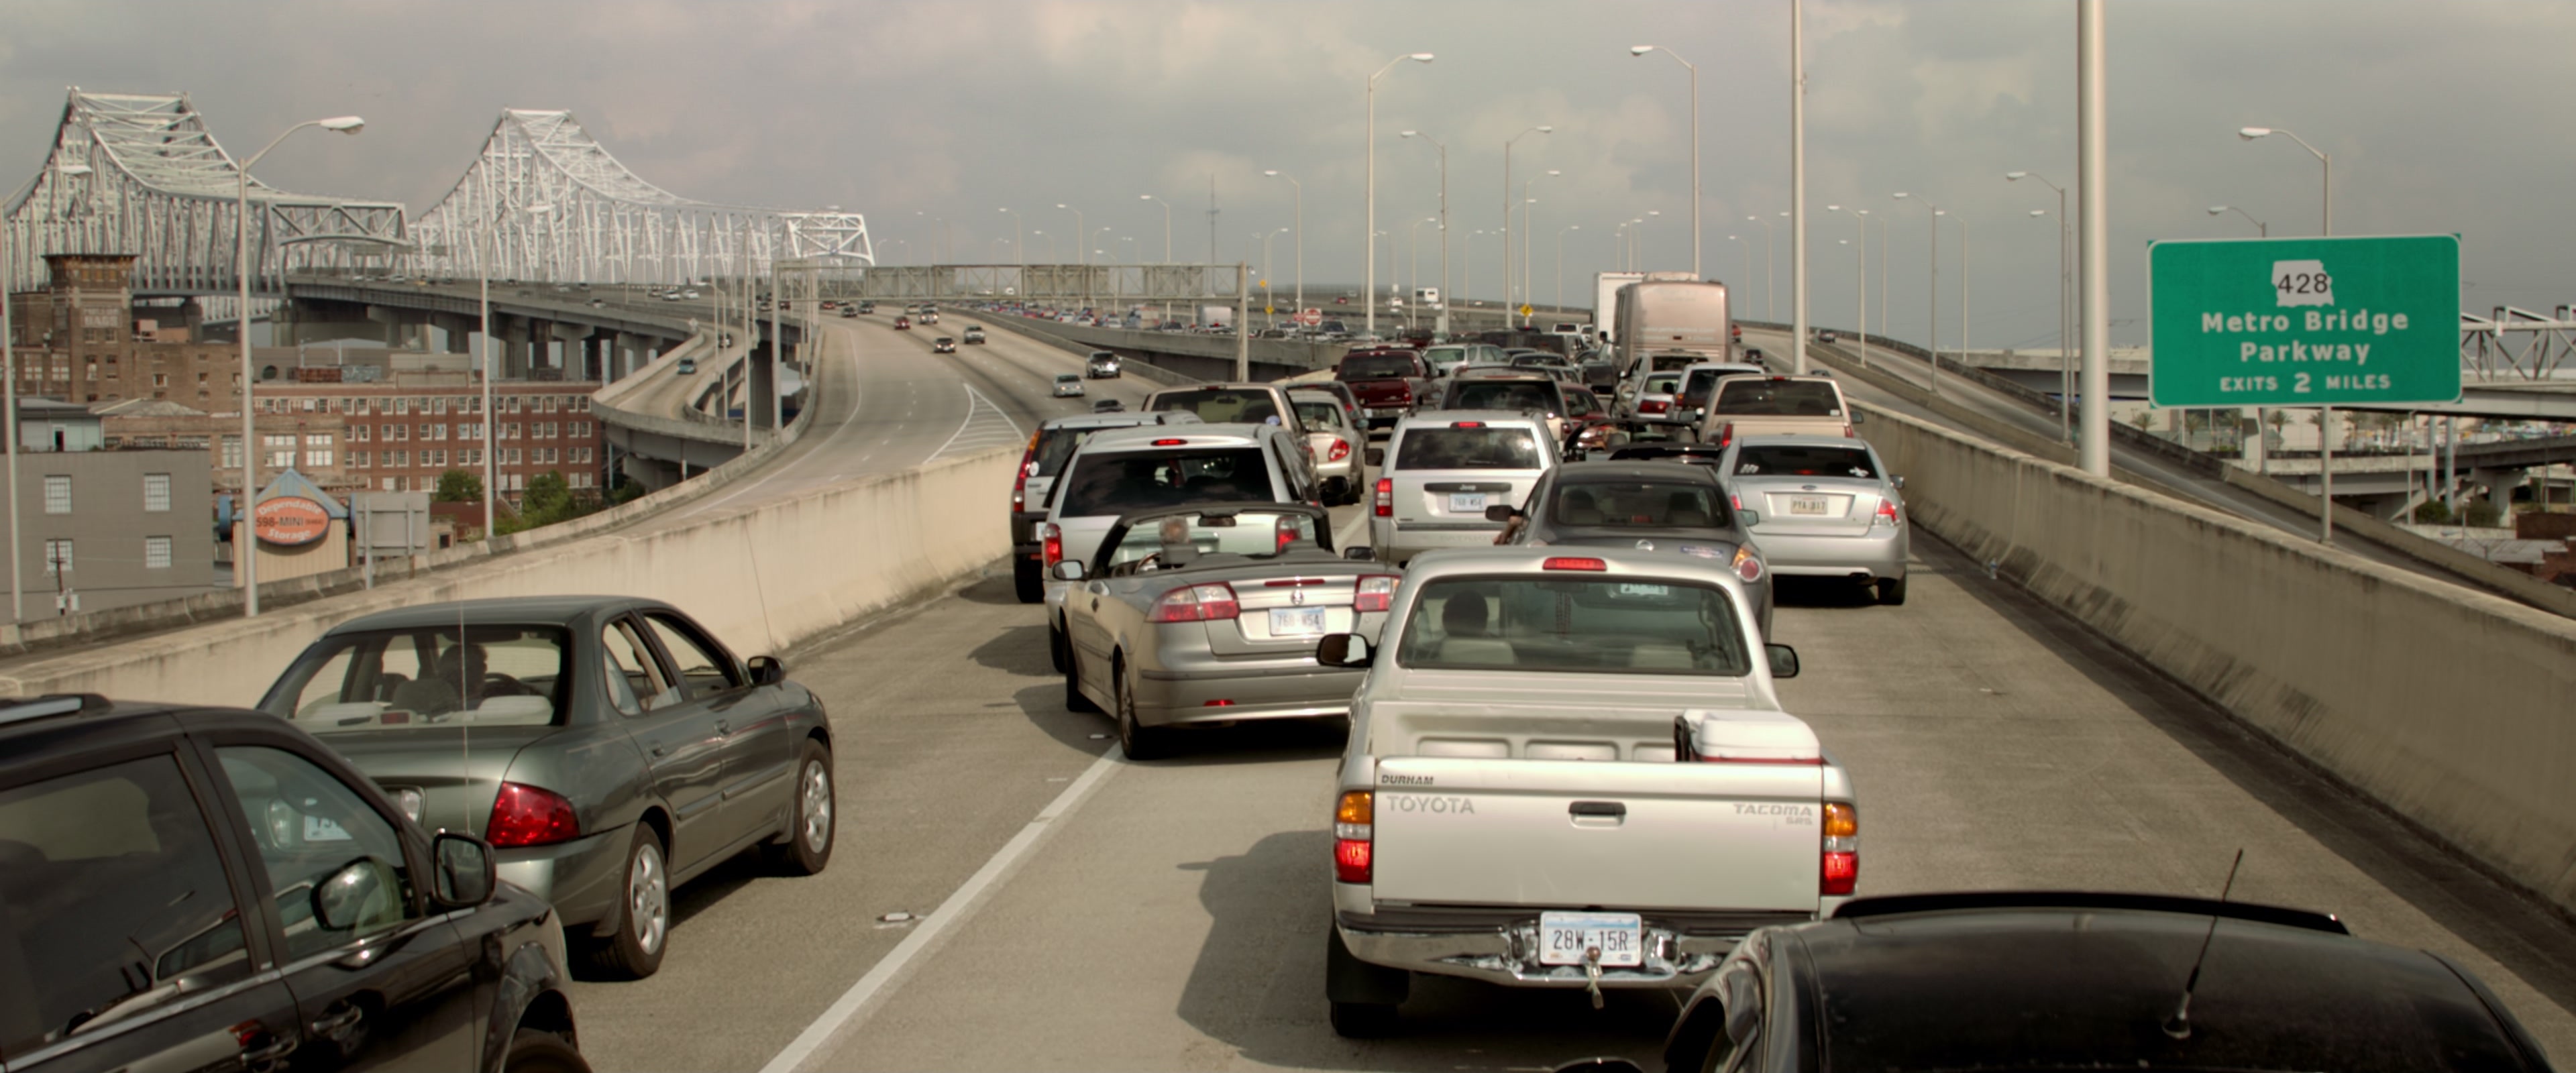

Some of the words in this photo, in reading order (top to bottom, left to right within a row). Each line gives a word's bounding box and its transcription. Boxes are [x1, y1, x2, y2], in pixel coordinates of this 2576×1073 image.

[2278, 273, 2328, 294] 428
[2202, 311, 2290, 333] Metro
[2305, 309, 2409, 335] Bridge
[2240, 339, 2371, 366] Parkway
[2220, 376, 2279, 392] EXITS
[2293, 372, 2312, 394] 2
[2325, 374, 2392, 390] MILES
[258, 500, 321, 516] Dependable
[268, 528, 311, 541] Storage
[1381, 775, 1434, 785] DURHAM
[1386, 795, 1475, 814] TOYOTA
[1733, 803, 1813, 816] TACOMA
